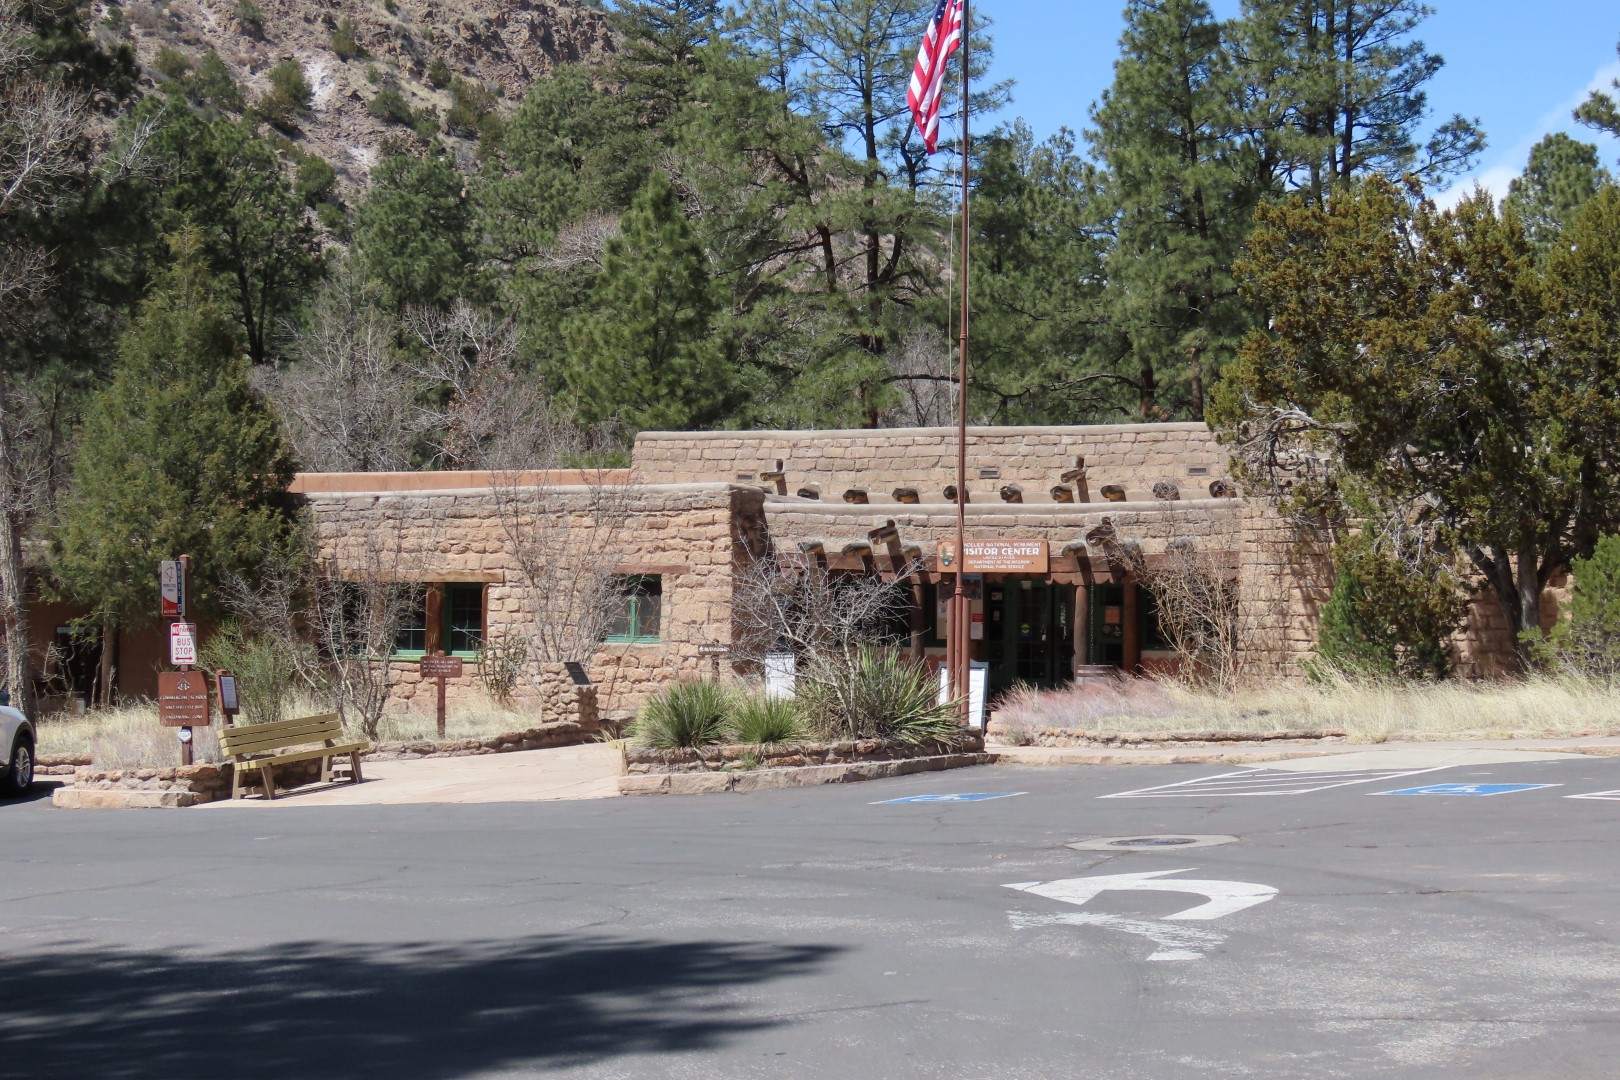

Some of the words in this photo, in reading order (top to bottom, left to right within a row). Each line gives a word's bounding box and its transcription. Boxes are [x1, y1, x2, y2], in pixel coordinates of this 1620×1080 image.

[172, 626, 180, 635] NO
[177, 637, 191, 646] BUS
[175, 647, 193, 655] STOP
